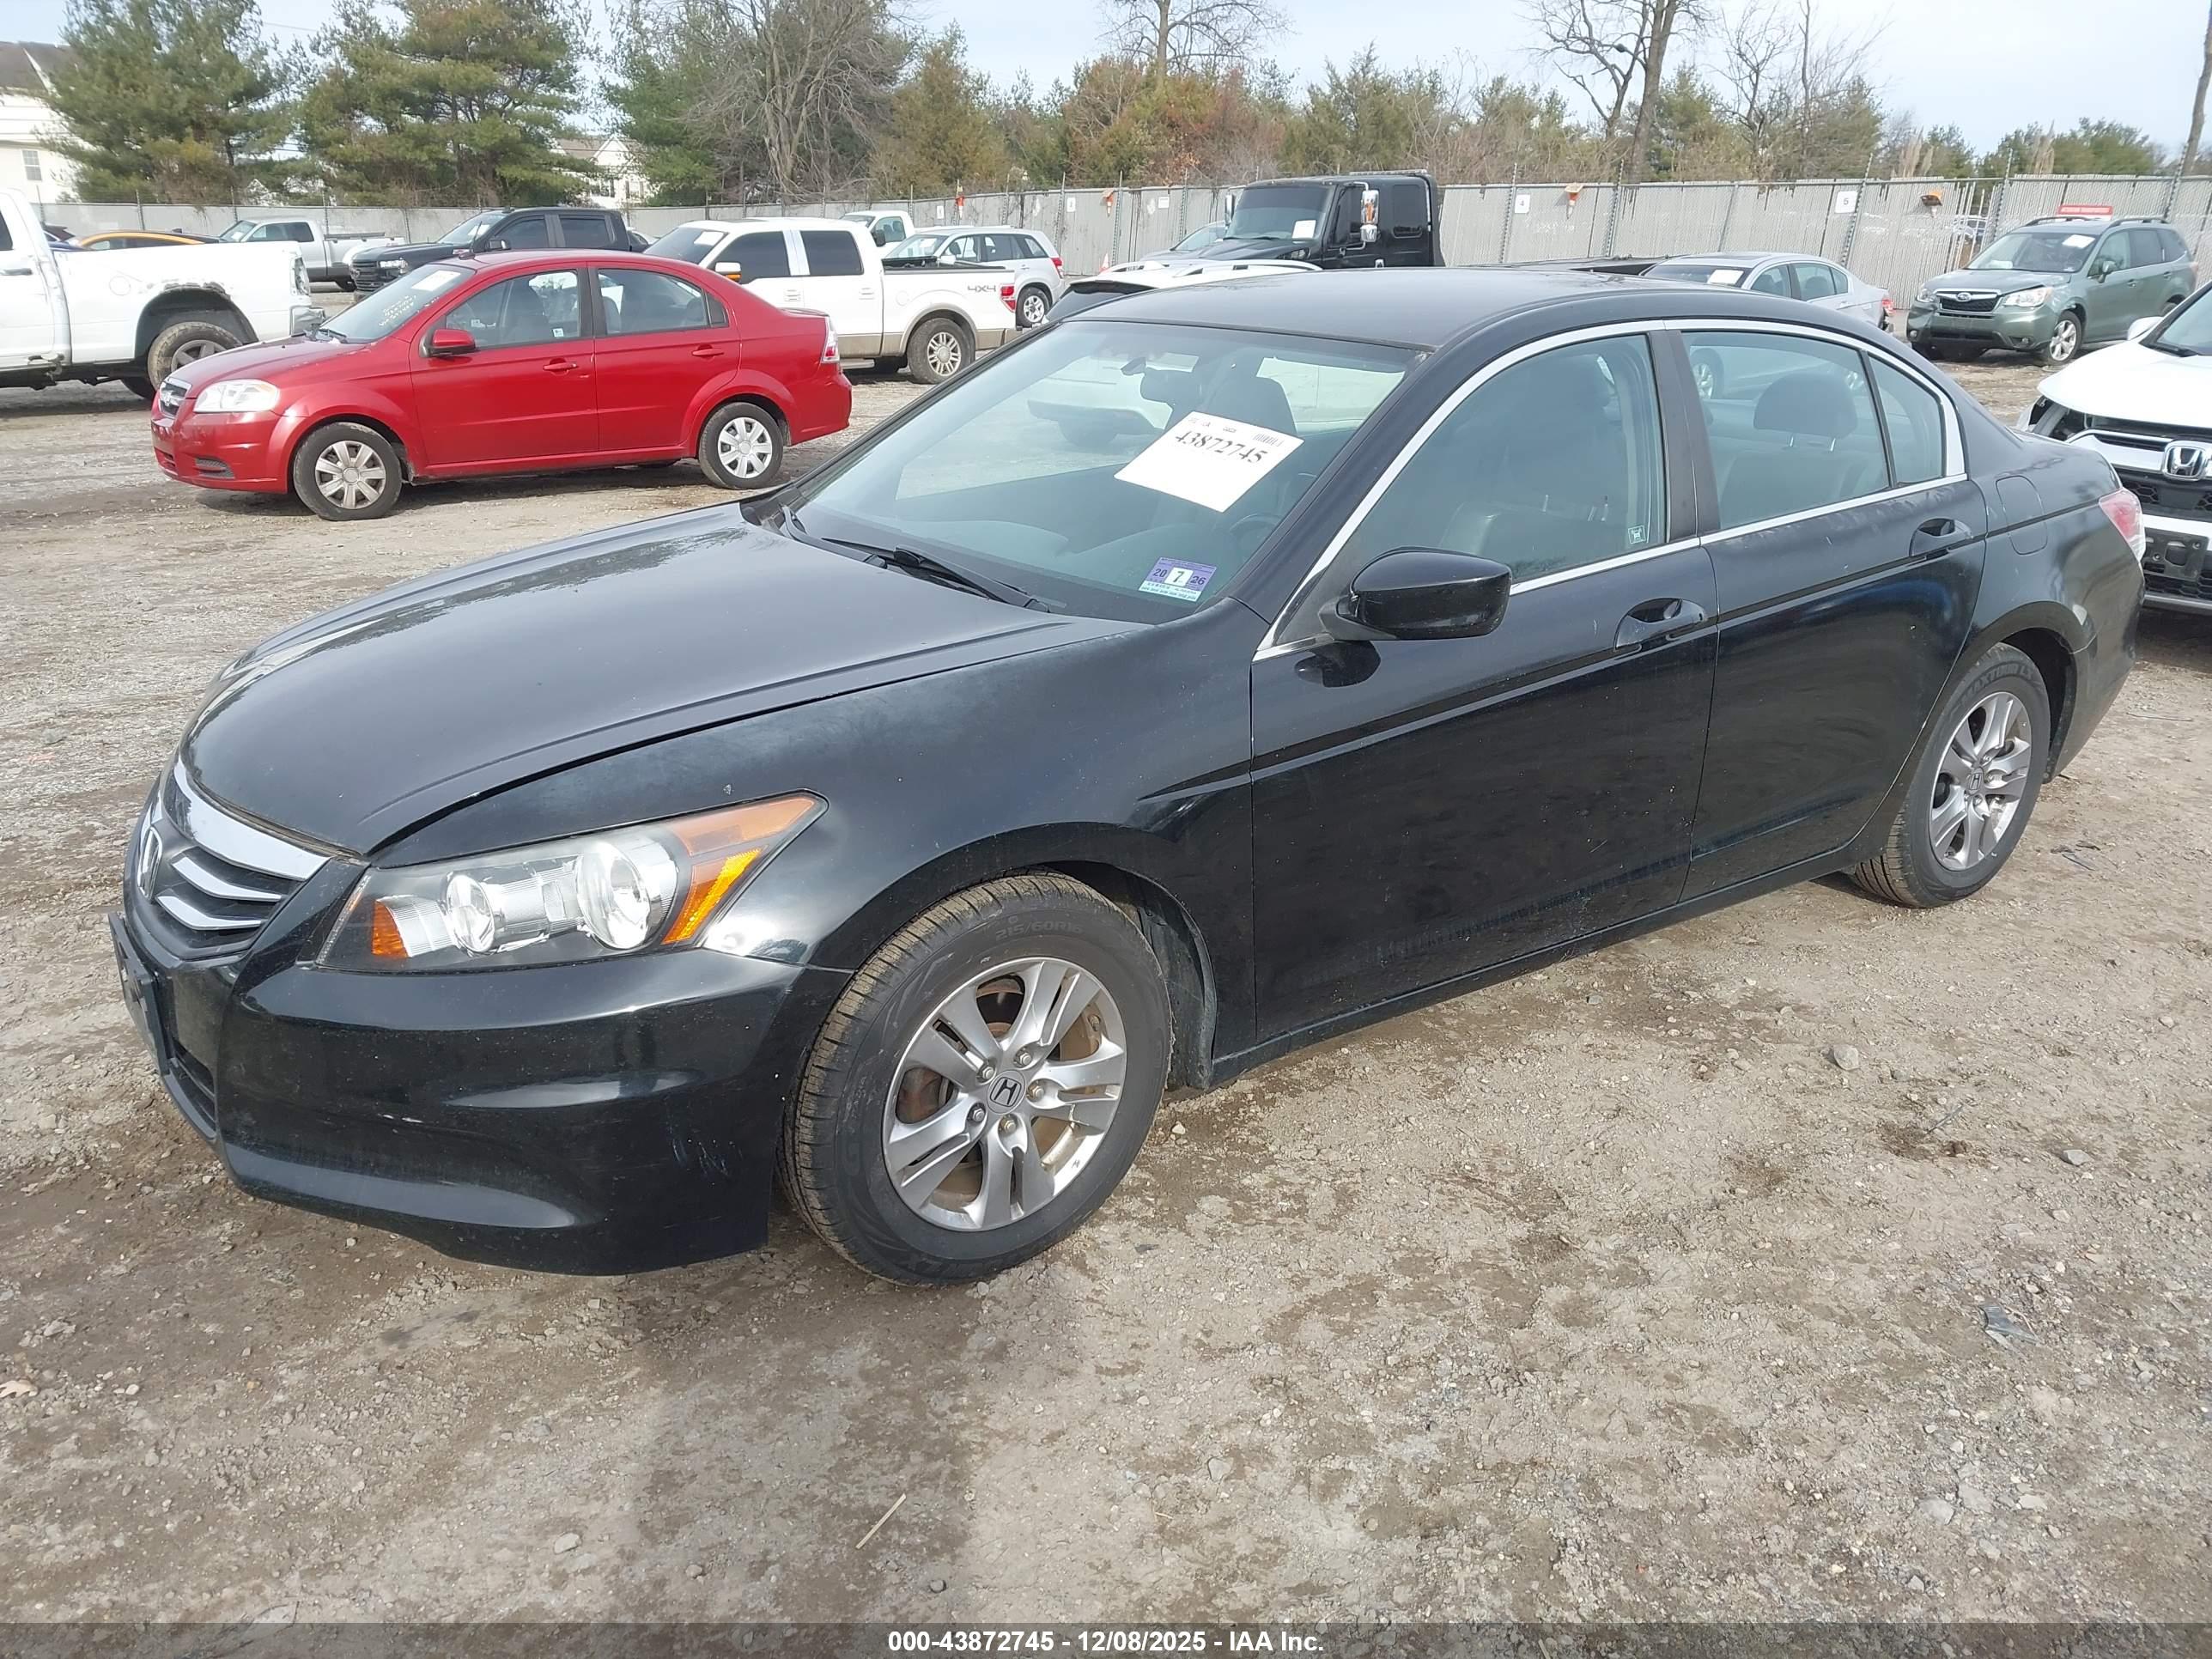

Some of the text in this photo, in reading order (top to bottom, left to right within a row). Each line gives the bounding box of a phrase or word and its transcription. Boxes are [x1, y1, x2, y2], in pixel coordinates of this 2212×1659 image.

[1175, 430, 1268, 463] 43872745
[1152, 567, 1207, 586] 20 7 26
